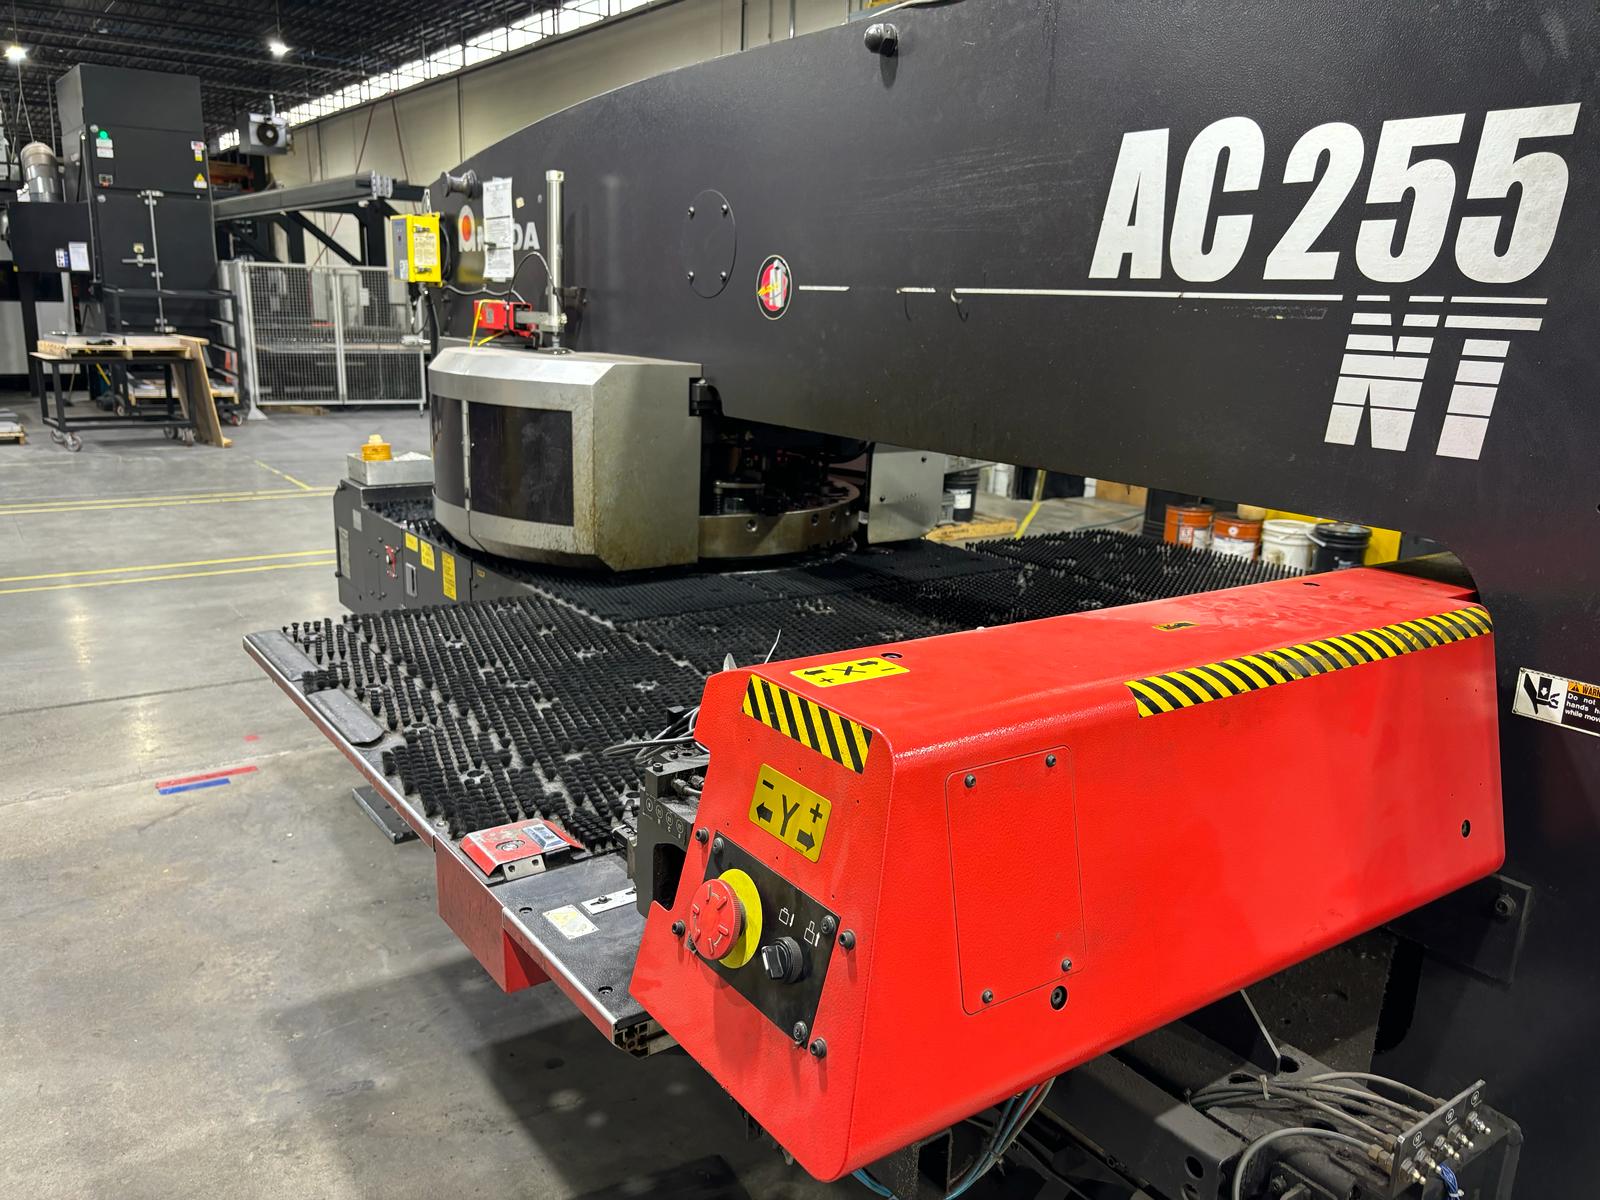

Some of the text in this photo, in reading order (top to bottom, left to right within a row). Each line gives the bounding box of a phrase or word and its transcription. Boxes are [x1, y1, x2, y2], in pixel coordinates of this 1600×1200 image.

[1088, 102, 1582, 283] AC 255
[1324, 295, 1548, 460] NT
[831, 665, 867, 676] X
[1566, 700, 1589, 712] hands
[1568, 692, 1596, 706] Do not
[1565, 709, 1582, 718] while
[779, 794, 800, 838] Y
